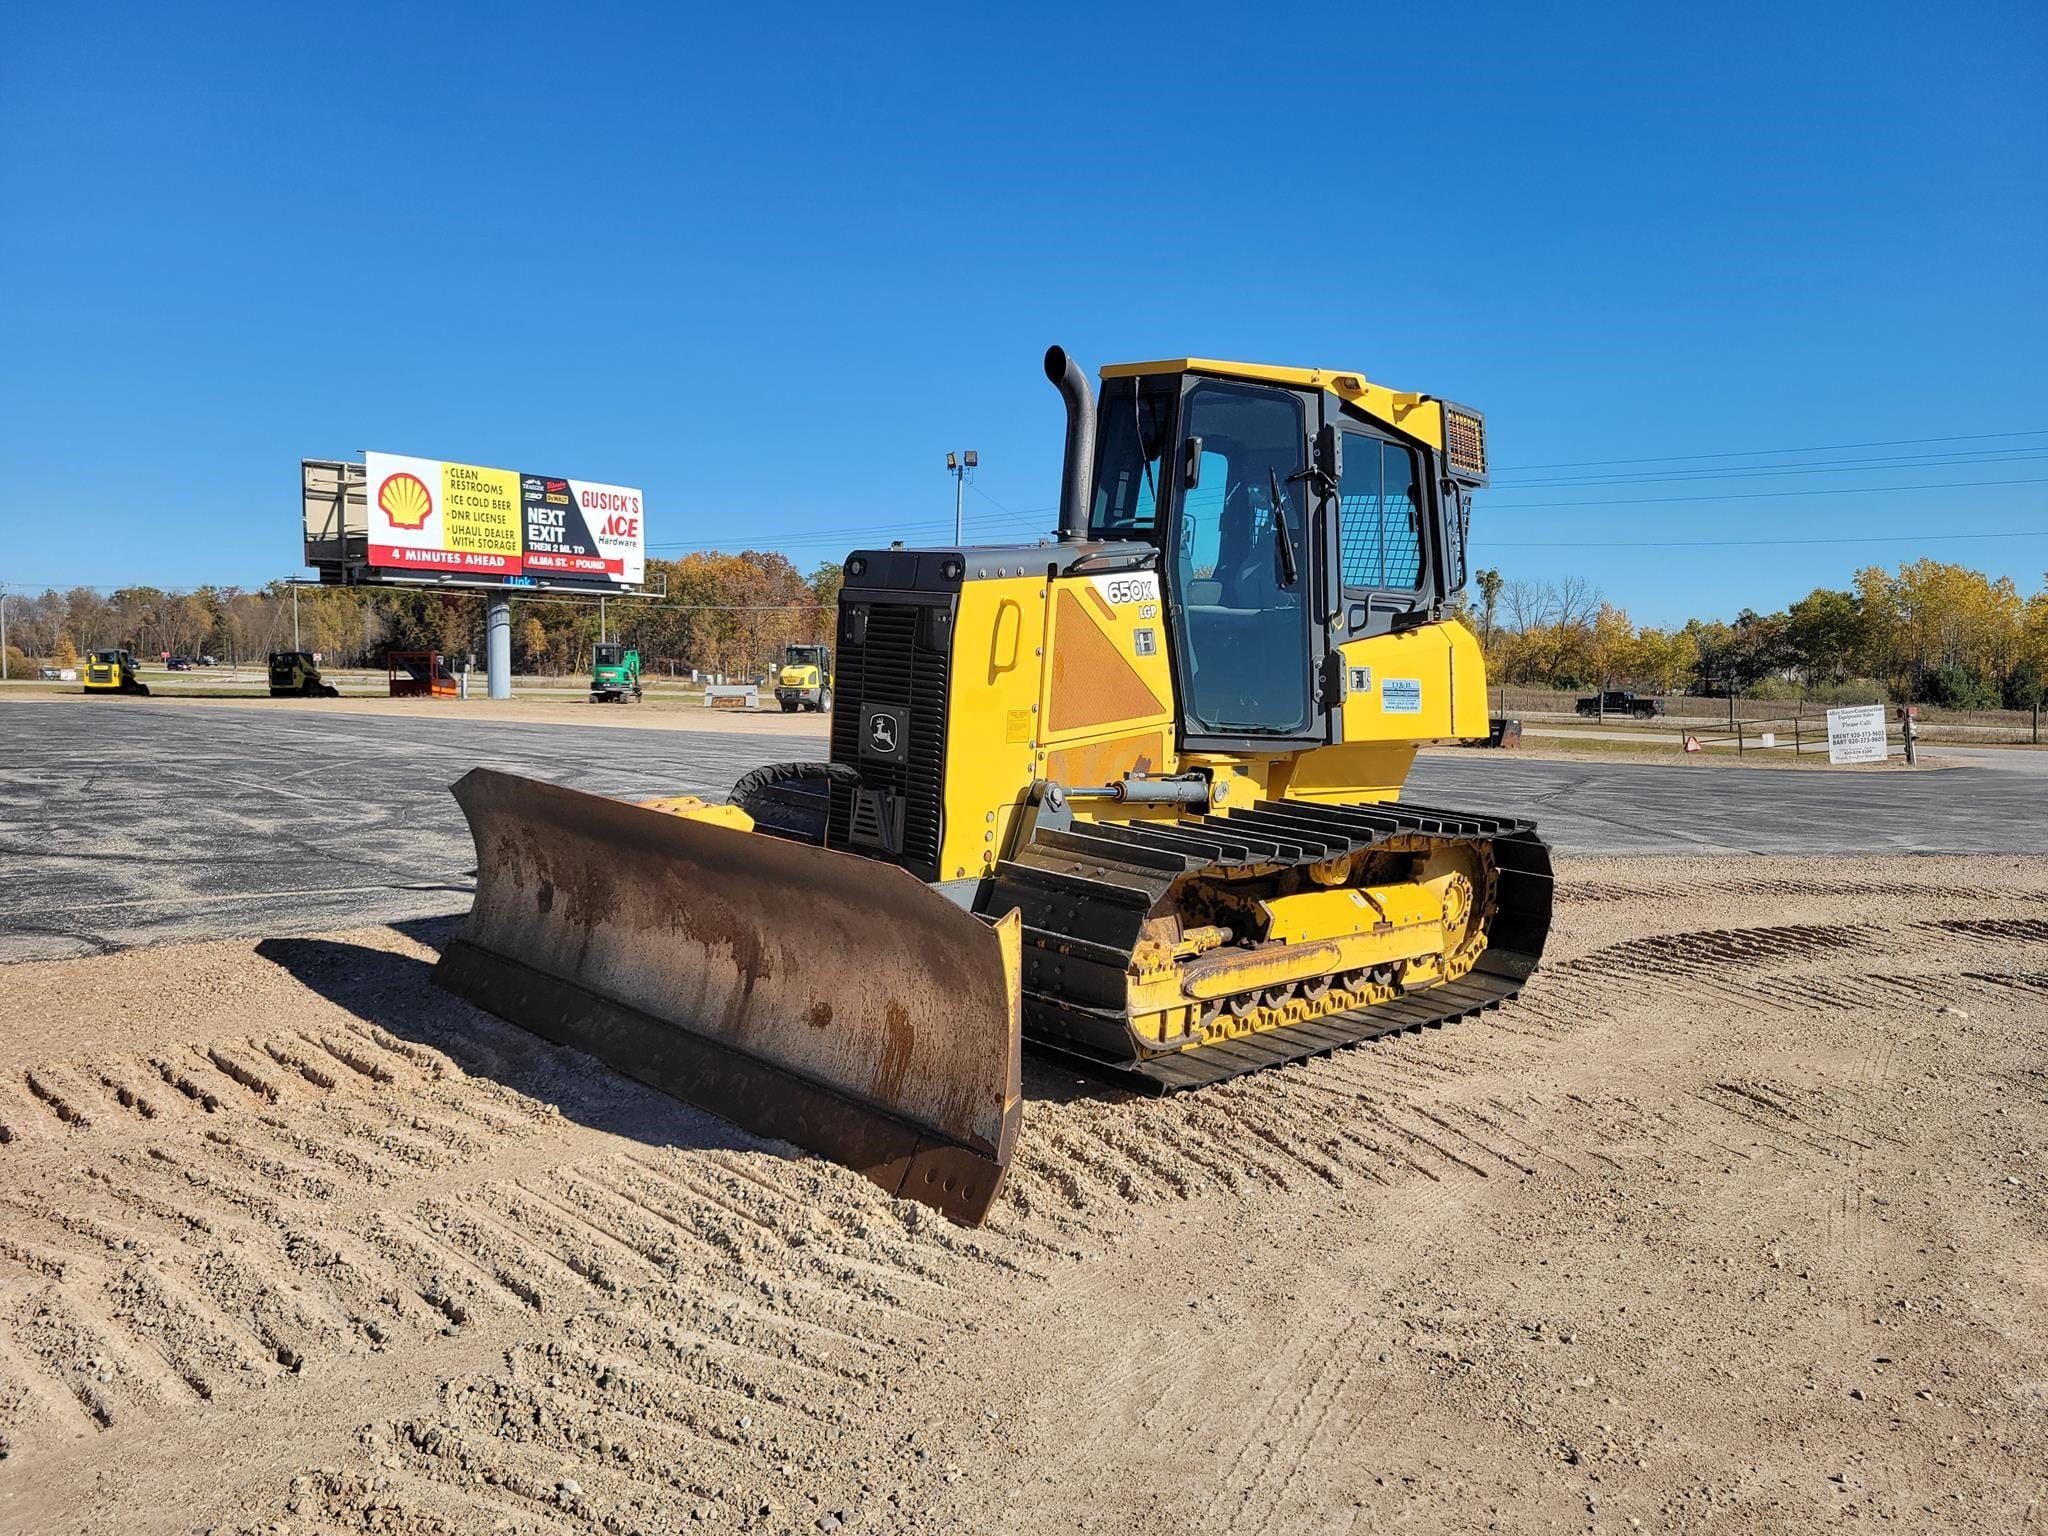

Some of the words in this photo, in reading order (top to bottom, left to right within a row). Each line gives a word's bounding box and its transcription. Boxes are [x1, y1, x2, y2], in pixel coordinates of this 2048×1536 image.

[450, 468, 478, 480] CLEAN
[450, 480, 503, 495] RESTROOMS
[451, 495, 464, 505] ICE
[467, 497, 490, 508] COLD
[492, 500, 512, 510] BEER
[582, 491, 639, 513] GUSICK'S
[451, 510, 471, 520] DNR
[473, 512, 506, 524] LICENSE
[527, 507, 566, 526] NEXT
[452, 525, 482, 537] UHAUL
[484, 528, 515, 540] DEALER
[600, 513, 639, 538] ACE
[528, 525, 566, 543] EXIT
[452, 536, 475, 547] WITH
[478, 539, 516, 551] STORAGE
[529, 542, 551, 551] THEN
[553, 544, 559, 553] 2
[573, 546, 585, 554] TO
[598, 537, 637, 548] Hardware
[392, 549, 400, 560] 4
[405, 550, 461, 564] MINUTES
[465, 554, 505, 567] AHEAD
[528, 557, 554, 566] ALMA
[555, 559, 568, 567] ST.
[576, 560, 606, 570] POUND
[1108, 580, 1154, 604] 650K
[1139, 605, 1157, 619] LGP
